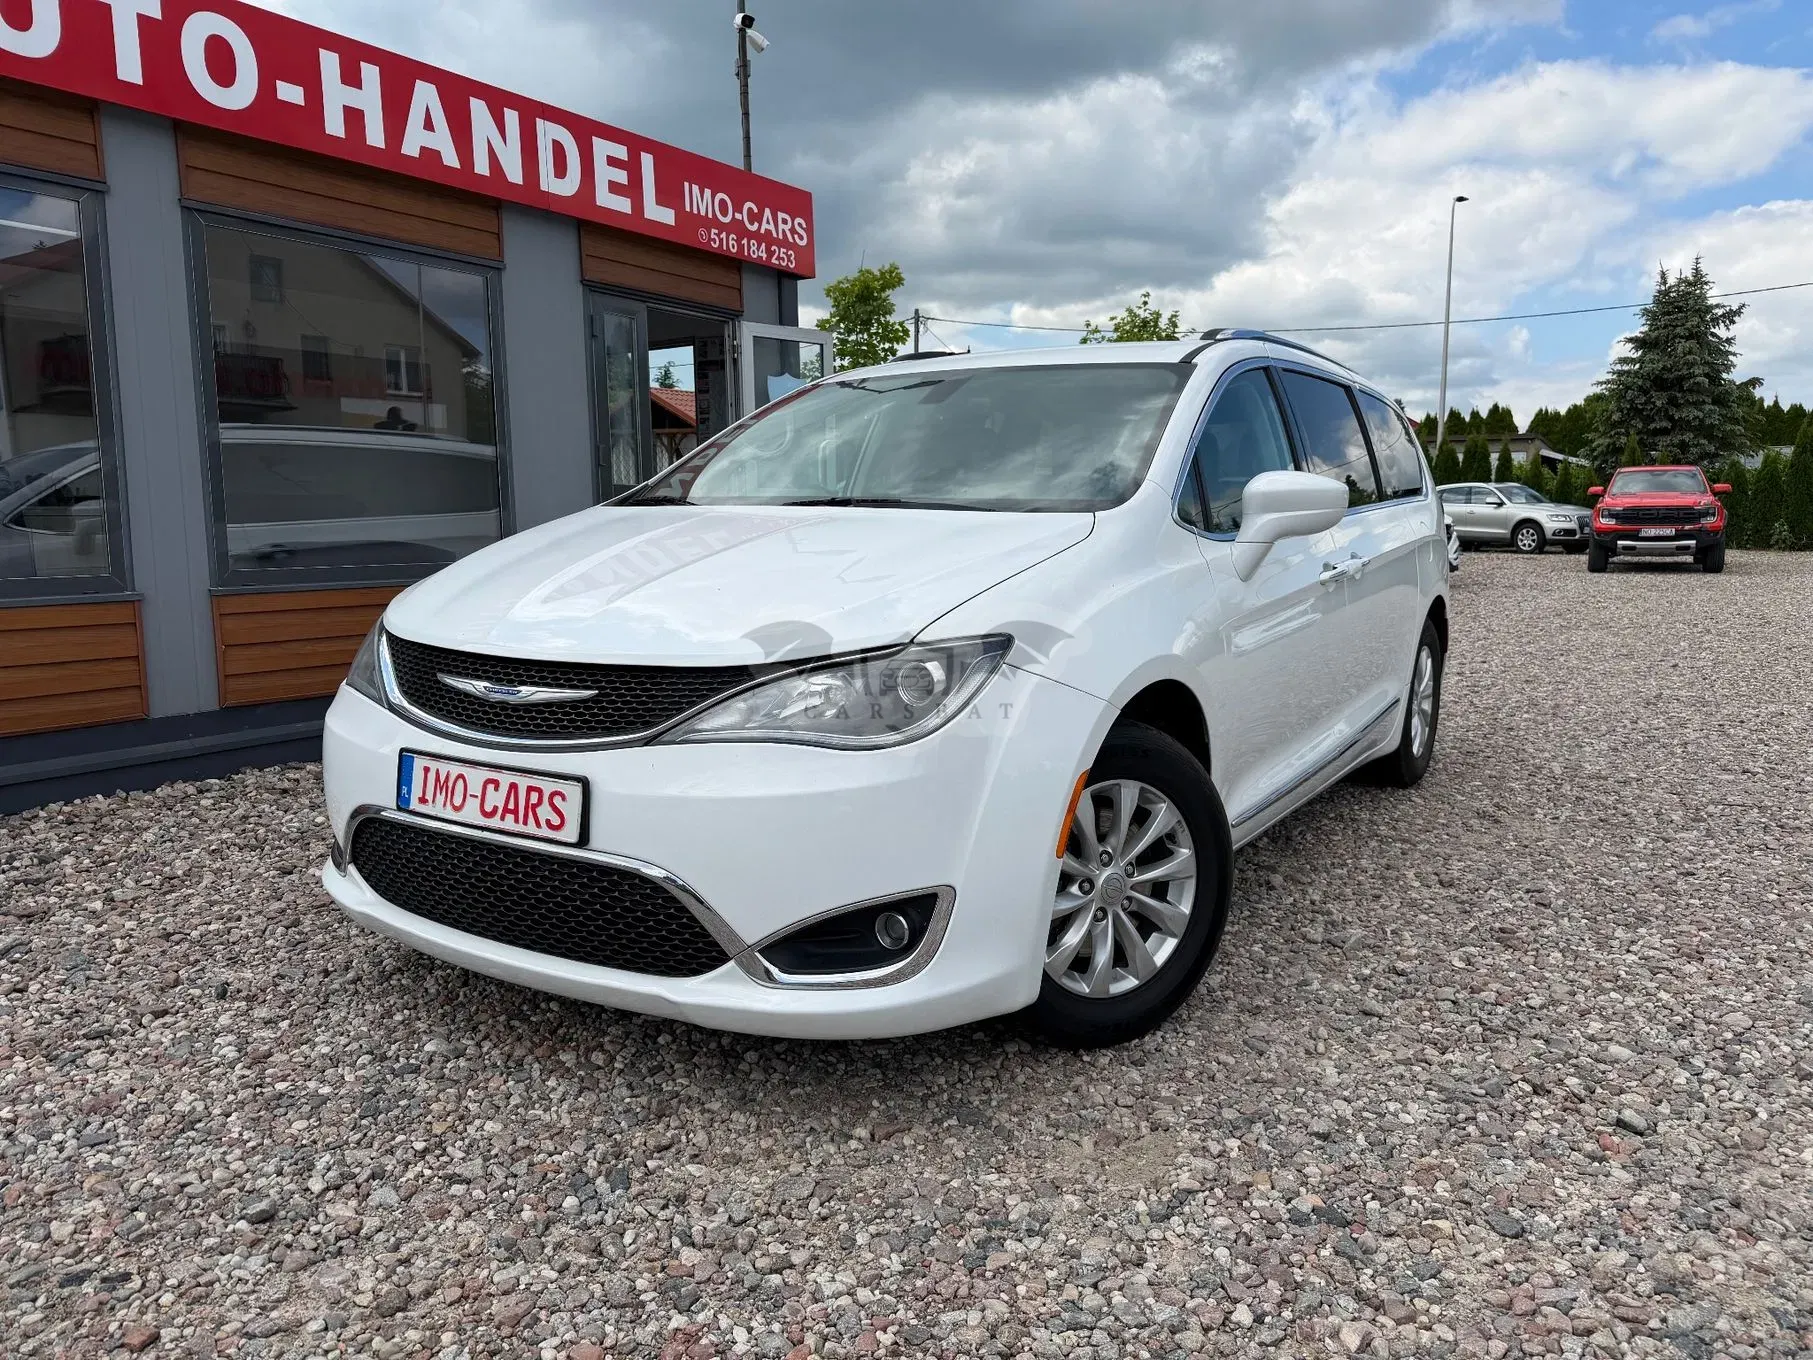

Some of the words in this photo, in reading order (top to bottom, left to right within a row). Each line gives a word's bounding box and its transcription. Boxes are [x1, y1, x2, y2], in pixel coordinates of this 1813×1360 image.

[683, 181, 808, 246] IMO-CARS
[710, 228, 738, 253] 516
[741, 237, 767, 261] 184
[770, 245, 796, 269] 253
[417, 765, 568, 832] IMO-CARS
